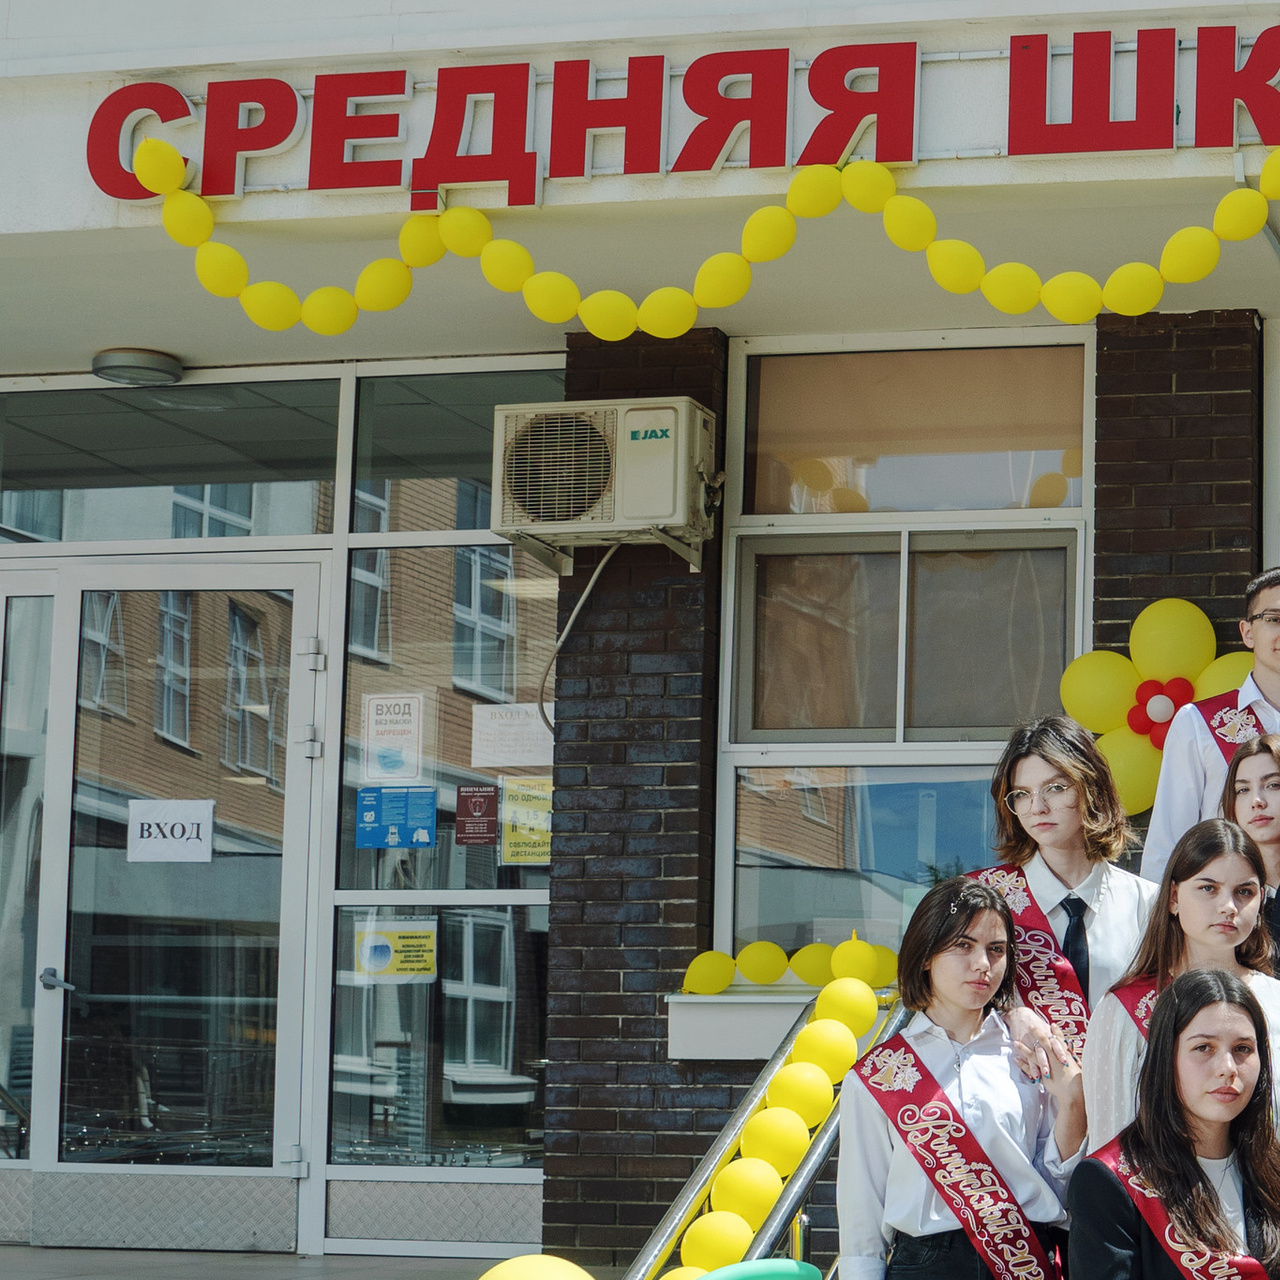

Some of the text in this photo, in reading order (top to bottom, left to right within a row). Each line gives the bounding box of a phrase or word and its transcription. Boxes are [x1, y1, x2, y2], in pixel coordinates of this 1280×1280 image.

[86, 41, 918, 211] СРЕДНЯЯ
[641, 428, 670, 440] JAX
[375, 702, 412, 718] ВХОД
[489, 710, 522, 721] ВХОД
[389, 718, 412, 726] МАСКИ
[375, 728, 412, 737] ЗАПРЕЩЕН
[516, 783, 546, 792] ХОДИТЕ
[508, 794, 519, 802] ПО
[525, 810, 539, 822] 1,5
[138, 822, 203, 843] ВХОД
[508, 841, 552, 849] СОБЛЮДАЙТ
[897, 1100, 1031, 1244] Выпускник
